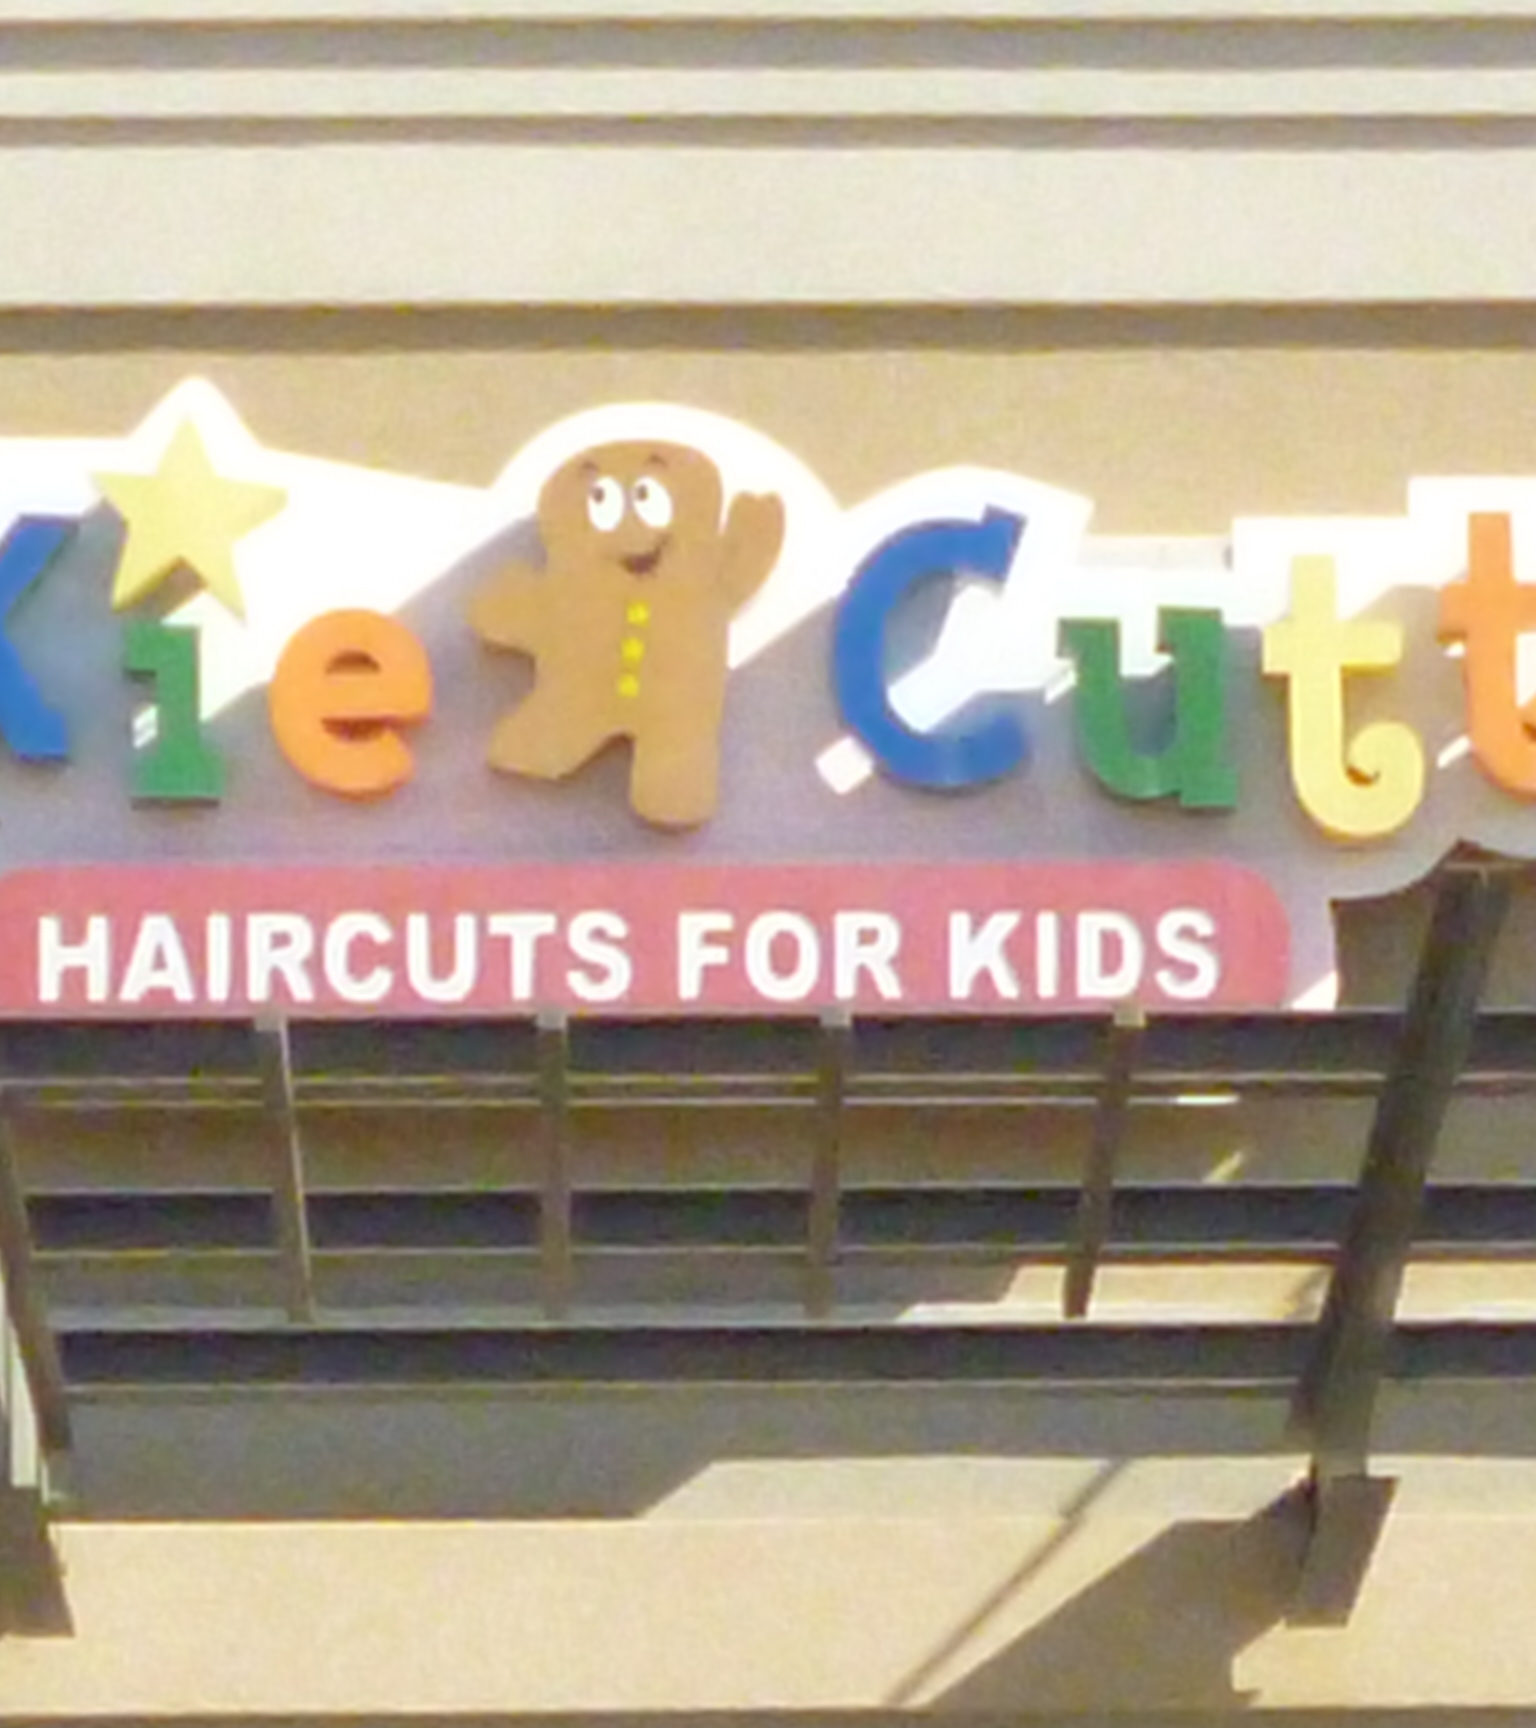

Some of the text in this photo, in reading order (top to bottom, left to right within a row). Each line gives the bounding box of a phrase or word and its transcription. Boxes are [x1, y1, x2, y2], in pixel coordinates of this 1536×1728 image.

[36, 910, 1221, 1003] HAIRCUTS FOR KIDS
